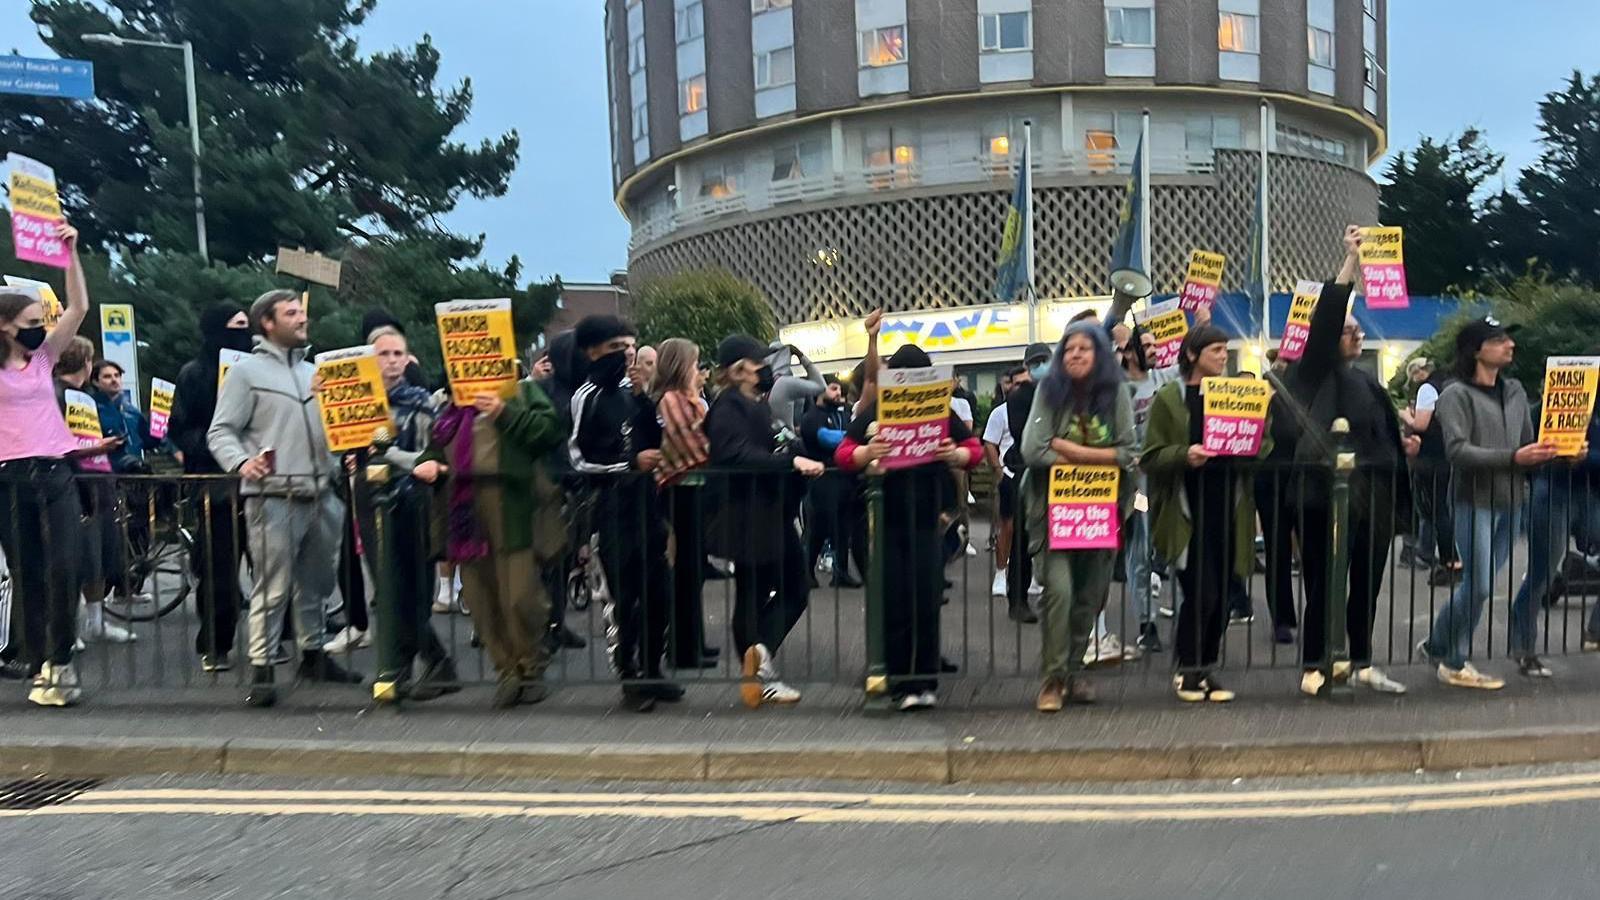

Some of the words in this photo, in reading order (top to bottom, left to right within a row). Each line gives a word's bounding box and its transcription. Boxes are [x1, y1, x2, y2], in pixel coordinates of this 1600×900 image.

[14, 214, 42, 236] Stop
[16, 232, 35, 249] far
[1192, 252, 1222, 269] Refugees
[1363, 266, 1385, 284] Stop
[1385, 266, 1401, 281] the
[1185, 283, 1204, 298] Stop
[1366, 282, 1381, 298] far
[1381, 282, 1404, 300] right
[1181, 297, 1196, 309] far
[442, 315, 488, 334] SMASH
[880, 308, 1009, 345] WAVE
[447, 337, 503, 357] FASCISM
[1283, 337, 1302, 352] far
[451, 361, 460, 379] &
[462, 358, 513, 378] RACISM
[1549, 371, 1585, 387] SMASH
[322, 382, 375, 404] FASCISM
[882, 387, 949, 404] Refugees
[1208, 380, 1267, 398] Refugees
[1209, 396, 1263, 413] welcome
[1546, 391, 1590, 408] FASCISM
[325, 408, 336, 425] &
[338, 402, 387, 422] RACISM
[882, 403, 946, 419] welcome
[1206, 417, 1238, 437] Stop
[1238, 419, 1259, 436] the
[1544, 414, 1554, 428] &
[1557, 413, 1588, 429] RACIS
[880, 426, 916, 444] Stop
[917, 423, 943, 438] the
[904, 439, 940, 457] right
[1206, 434, 1227, 451] far
[1225, 435, 1255, 455] right
[1055, 468, 1117, 485] Refugees
[1054, 484, 1112, 498] welcome
[1051, 504, 1085, 524] Stop
[1085, 504, 1111, 521] the
[1052, 521, 1075, 538] far
[1075, 520, 1111, 541] right
